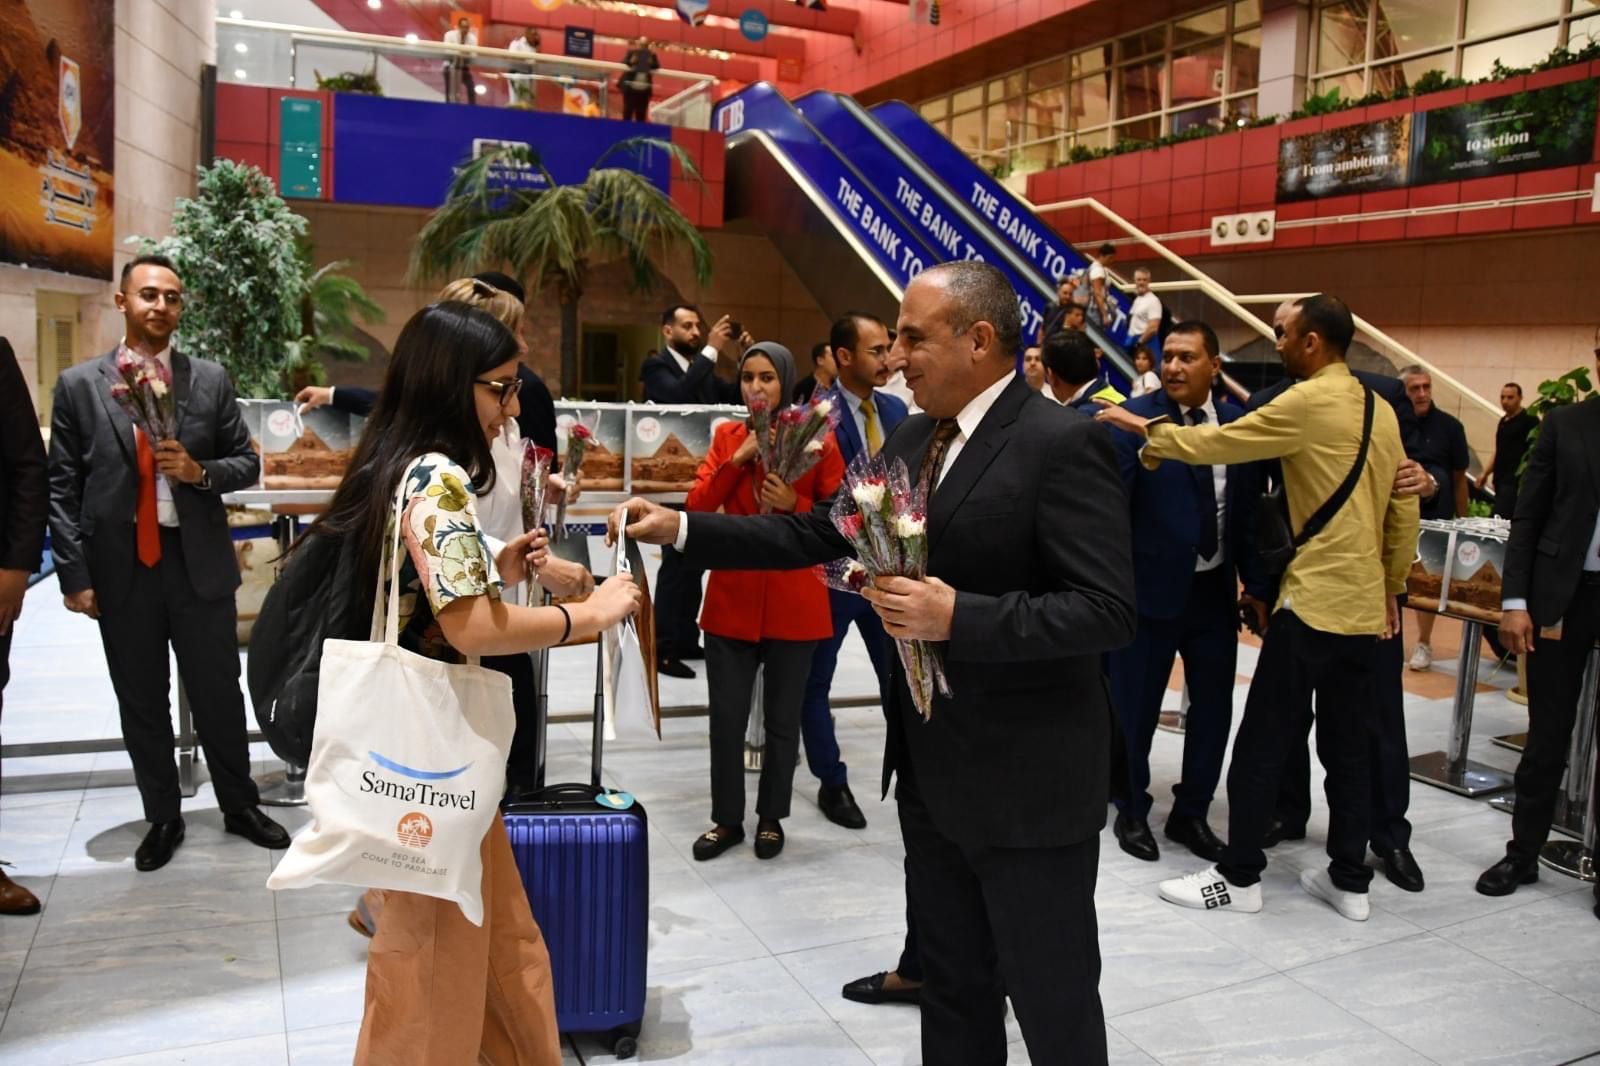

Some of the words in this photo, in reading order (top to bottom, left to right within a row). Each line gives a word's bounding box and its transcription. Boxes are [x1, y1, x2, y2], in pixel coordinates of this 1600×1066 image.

[1466, 140, 1480, 153] to
[1482, 131, 1530, 150] action
[1302, 163, 1333, 177] From
[1334, 154, 1389, 173] ambition
[837, 176, 863, 219] THE
[860, 203, 902, 261] BANK
[901, 245, 924, 282] TO
[895, 176, 923, 217] THE
[920, 202, 963, 257] BANK
[970, 181, 999, 221] THE
[998, 207, 1043, 260] BANK
[1042, 245, 1067, 282] TO
[360, 770, 476, 811] SamaTravel
[360, 851, 389, 865] COME
[391, 860, 402, 869] TO
[391, 852, 408, 862] RED
[411, 855, 427, 865] SEA
